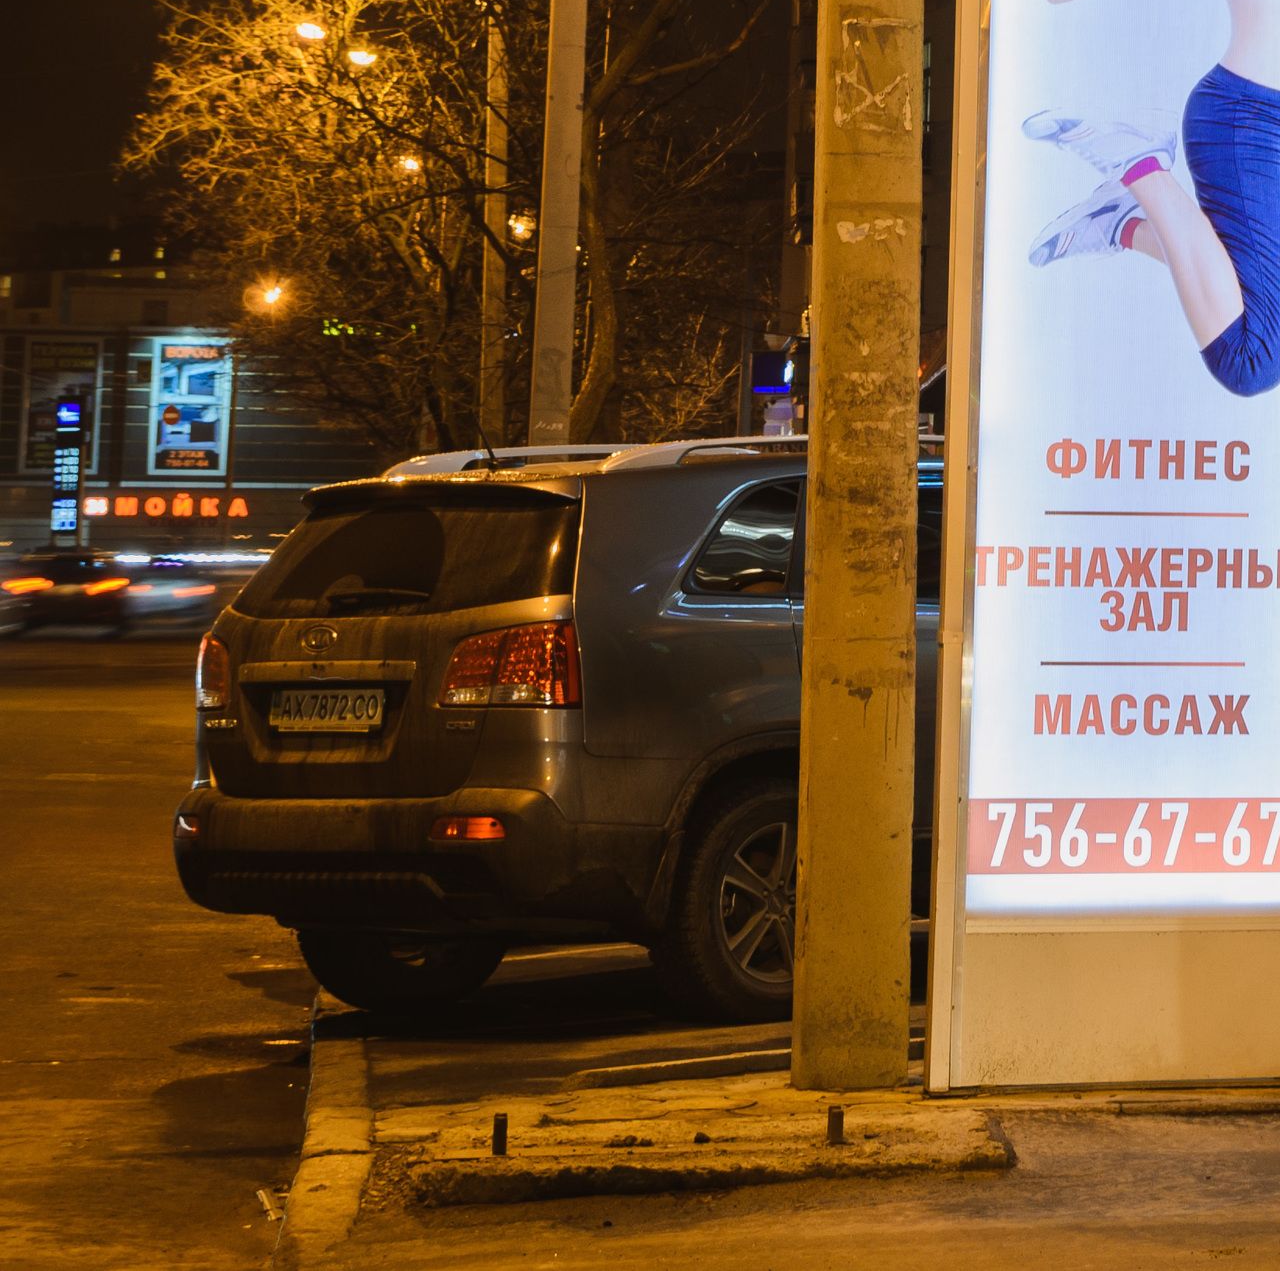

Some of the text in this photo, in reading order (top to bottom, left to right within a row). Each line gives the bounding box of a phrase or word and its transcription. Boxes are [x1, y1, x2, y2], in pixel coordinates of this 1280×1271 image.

[1045, 437, 1252, 483] ФИТНЕС
[114, 492, 249, 517] МОЙКА
[1099, 591, 1189, 632] ЗАЛ
[308, 694, 350, 721] 7872
[1033, 693, 1251, 736] МАССАЖ
